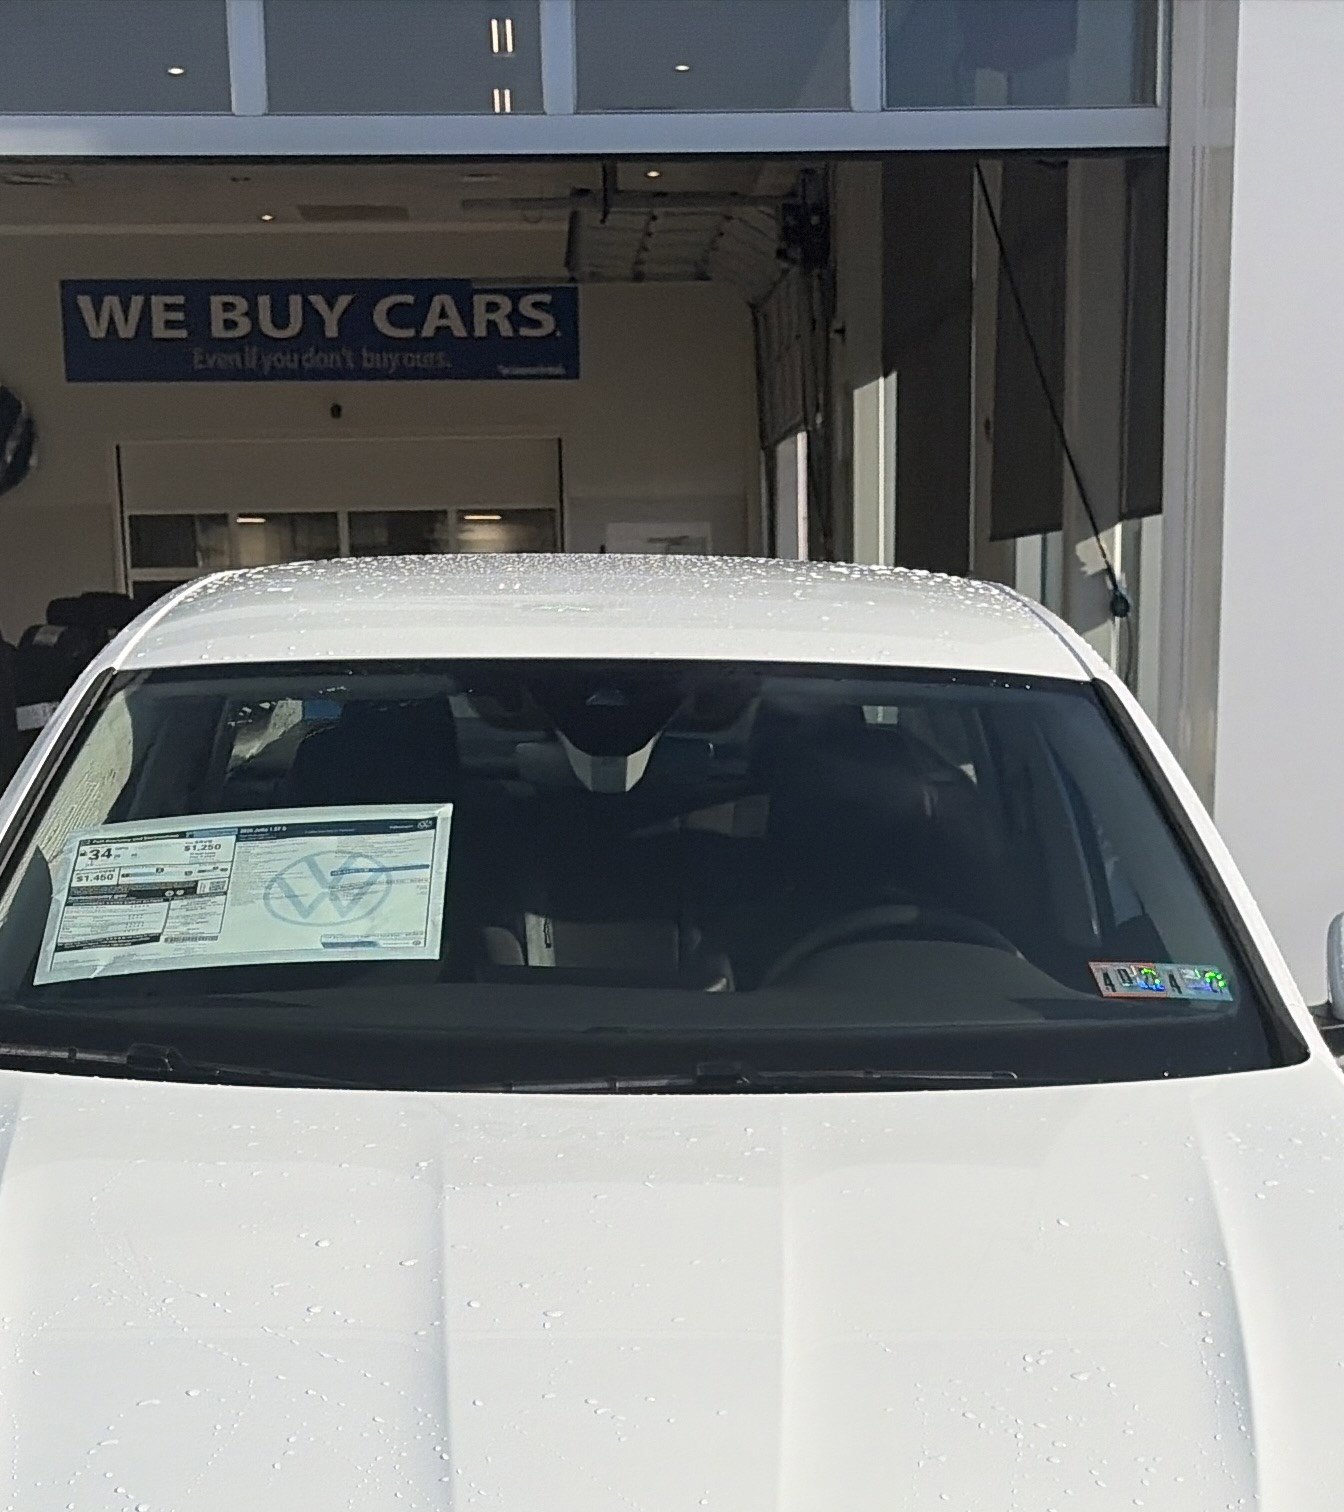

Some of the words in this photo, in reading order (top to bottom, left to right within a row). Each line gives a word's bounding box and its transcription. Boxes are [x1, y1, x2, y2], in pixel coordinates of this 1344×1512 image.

[77, 294, 188, 339] WE
[210, 294, 356, 339] BUY
[192, 347, 243, 370] Even
[261, 353, 299, 375] you
[361, 347, 402, 374] buy
[88, 848, 113, 861] 34
